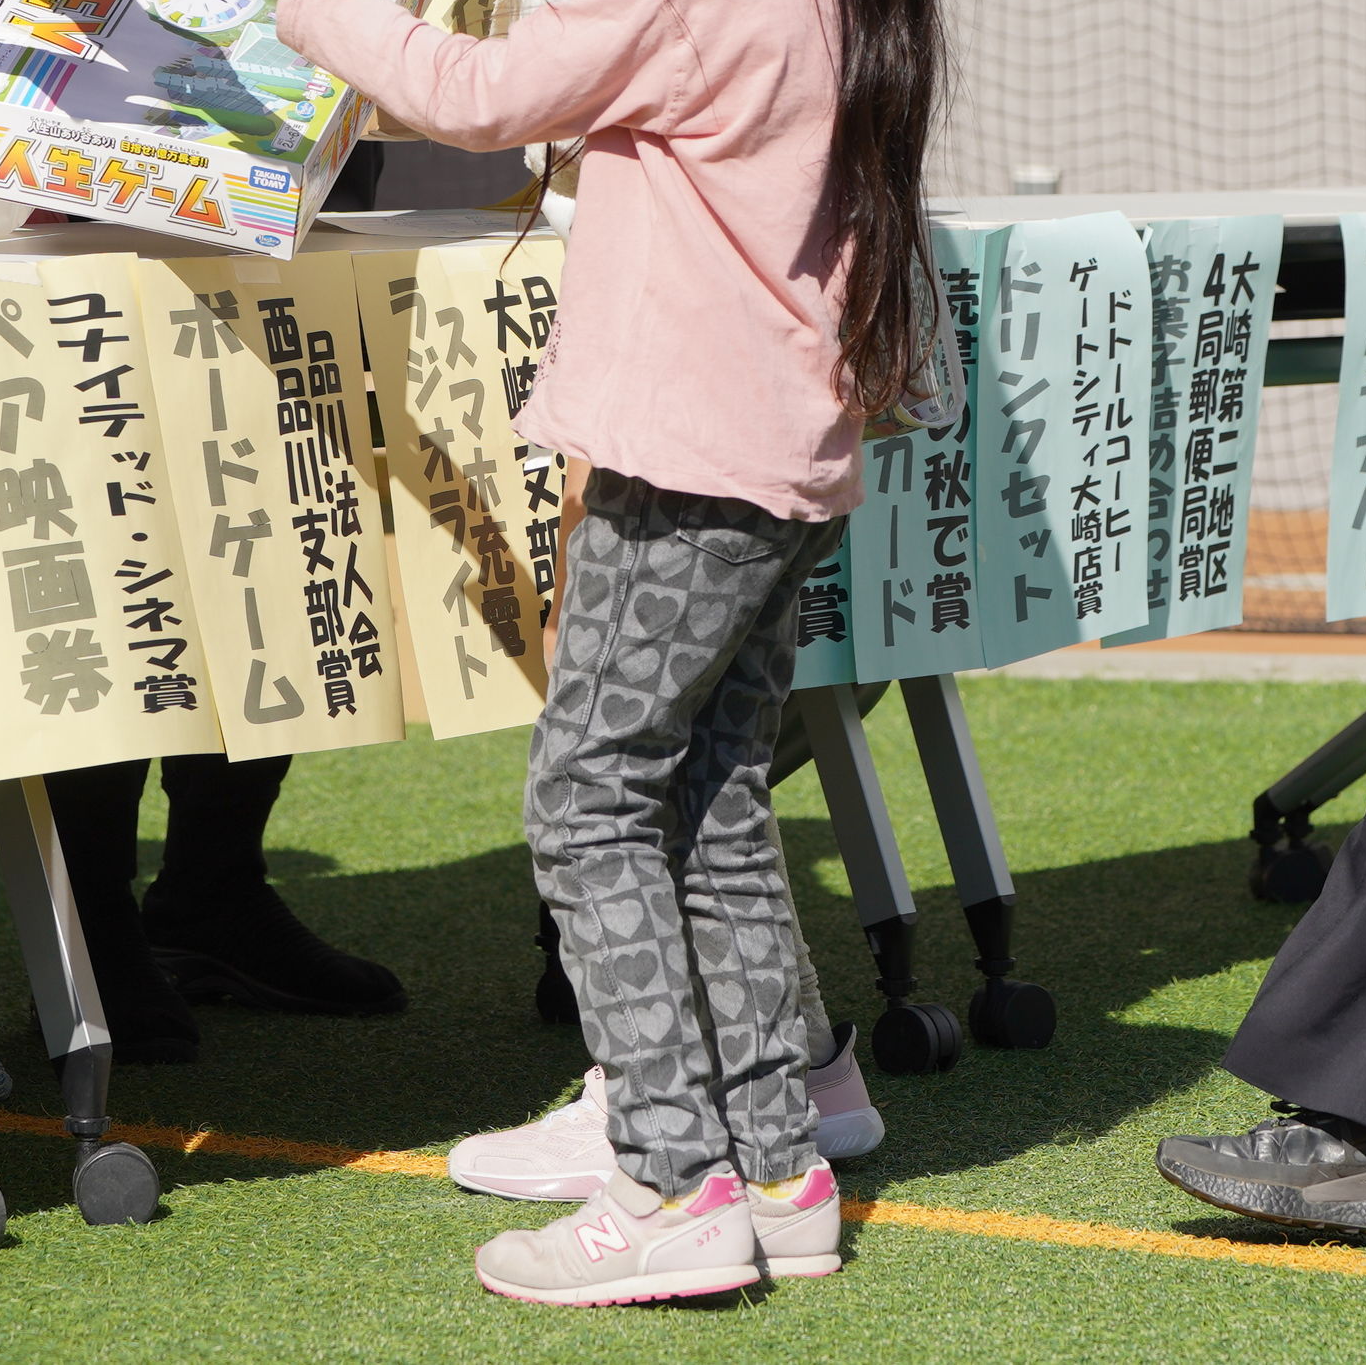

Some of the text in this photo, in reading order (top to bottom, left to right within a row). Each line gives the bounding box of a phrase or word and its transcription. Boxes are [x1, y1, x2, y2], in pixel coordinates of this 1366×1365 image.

[253, 177, 285, 190] TOMY
[254, 169, 286, 181] TAKARA
[47, 291, 199, 715] ユナイテッド・シネマ賞
[169, 289, 306, 725] ボードゲーム
[257, 296, 358, 720] 西品川支部賞
[305, 329, 385, 680] 品川法人会
[387, 275, 489, 702] ラジオライト
[436, 305, 528, 659] スマホ充電
[997, 261, 1053, 623] ドリンクセット
[1069, 257, 1104, 620] ゲートシティ大崎店賞
[1105, 289, 1133, 573] ドトールコーヒー
[1204, 250, 1261, 599] 大崎第二地区
